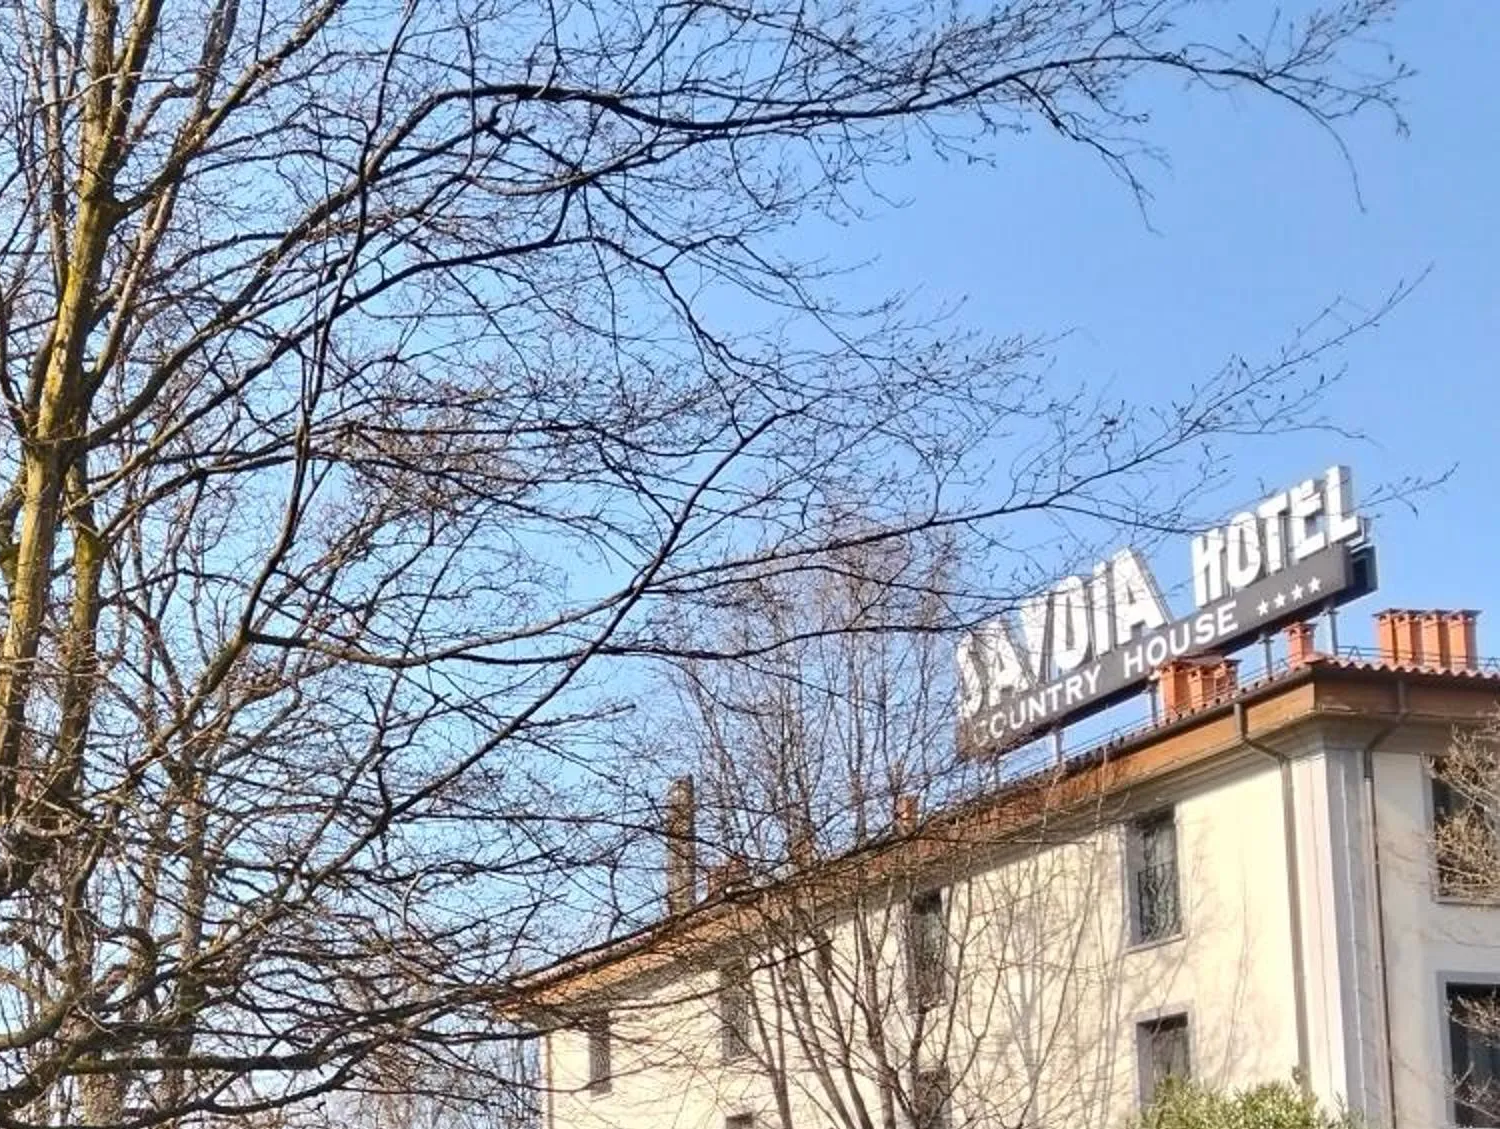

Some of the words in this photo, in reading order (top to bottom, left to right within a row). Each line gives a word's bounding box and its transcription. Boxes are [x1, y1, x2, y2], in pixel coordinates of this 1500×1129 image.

[956, 547, 1171, 718] SAVOIA
[1191, 464, 1360, 607] HOTEL
[973, 663, 1102, 747] COUNTRY
[1123, 603, 1239, 679] HOUSE
